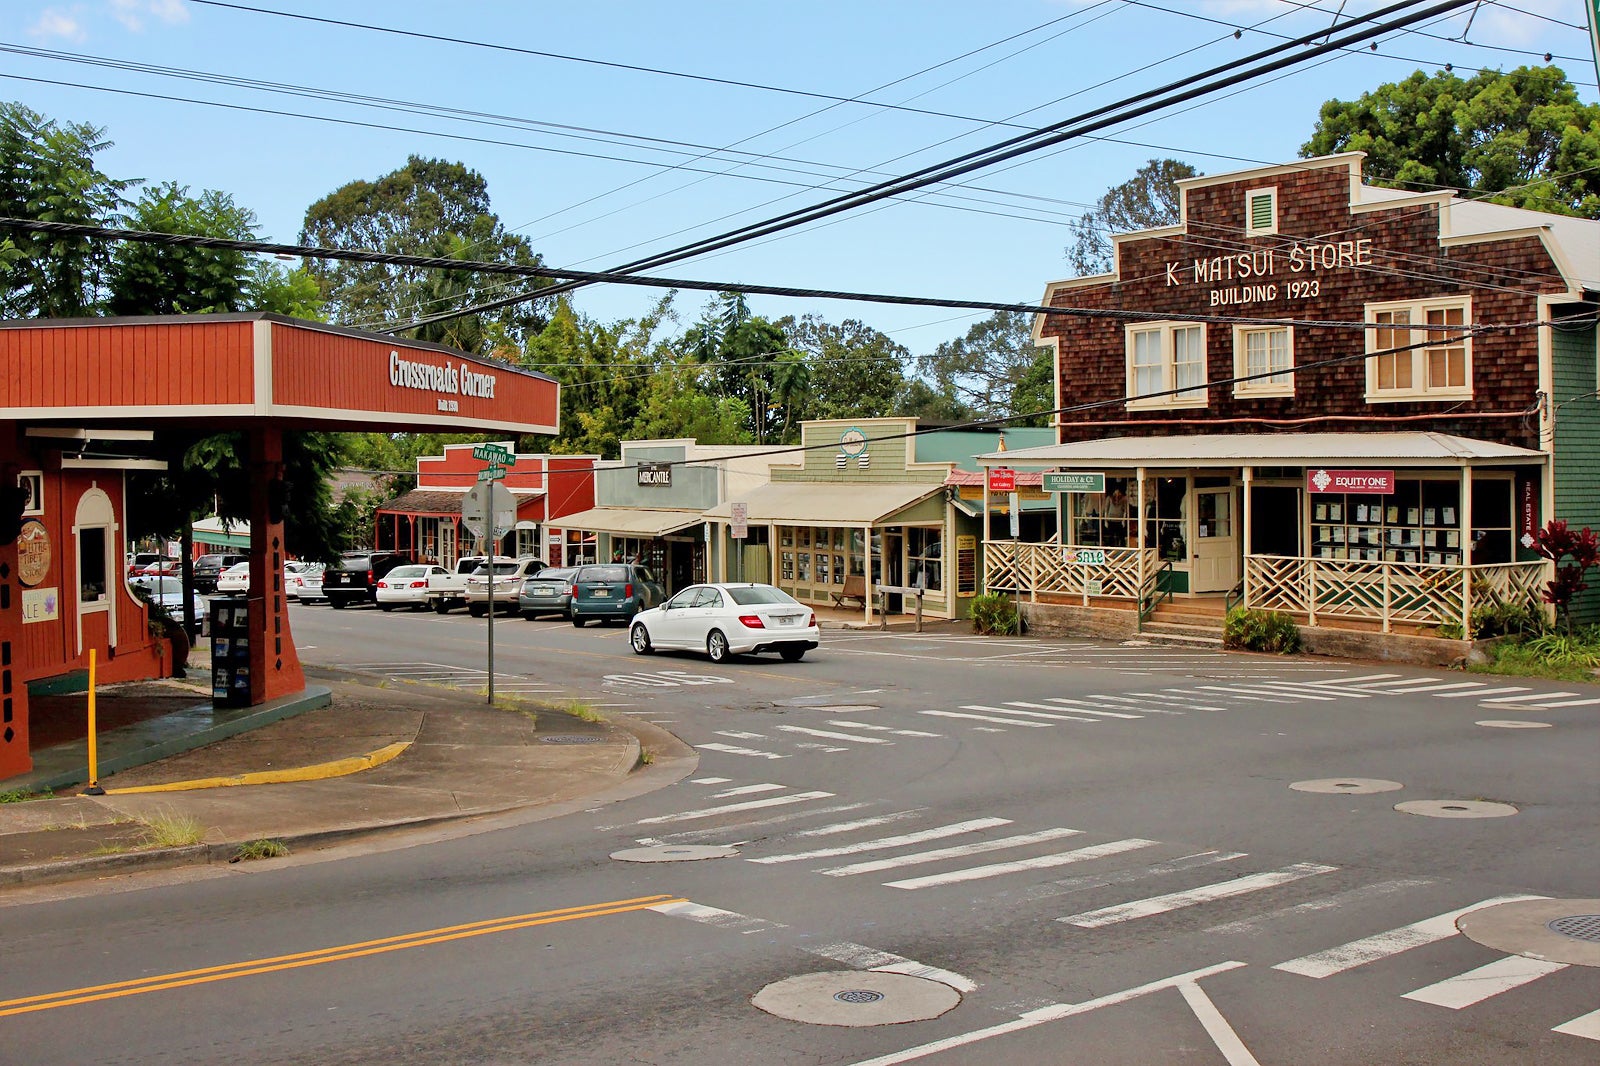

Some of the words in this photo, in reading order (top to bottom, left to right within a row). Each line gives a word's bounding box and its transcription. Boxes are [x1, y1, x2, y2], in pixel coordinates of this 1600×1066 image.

[1166, 261, 1180, 286] K
[1194, 250, 1274, 283] MATSUI
[1289, 239, 1373, 273] STORE
[1210, 284, 1277, 306] BUILDING
[1287, 280, 1320, 299] 1923
[389, 350, 458, 394] Crossroads
[460, 363, 496, 399] Corner
[473, 448, 507, 464] MAKAWAO
[639, 471, 670, 483] MERCANTILE
[1051, 475, 1079, 483] HOLIDAY
[1335, 477, 1367, 487] EQUITY
[1368, 477, 1388, 486] ONE
